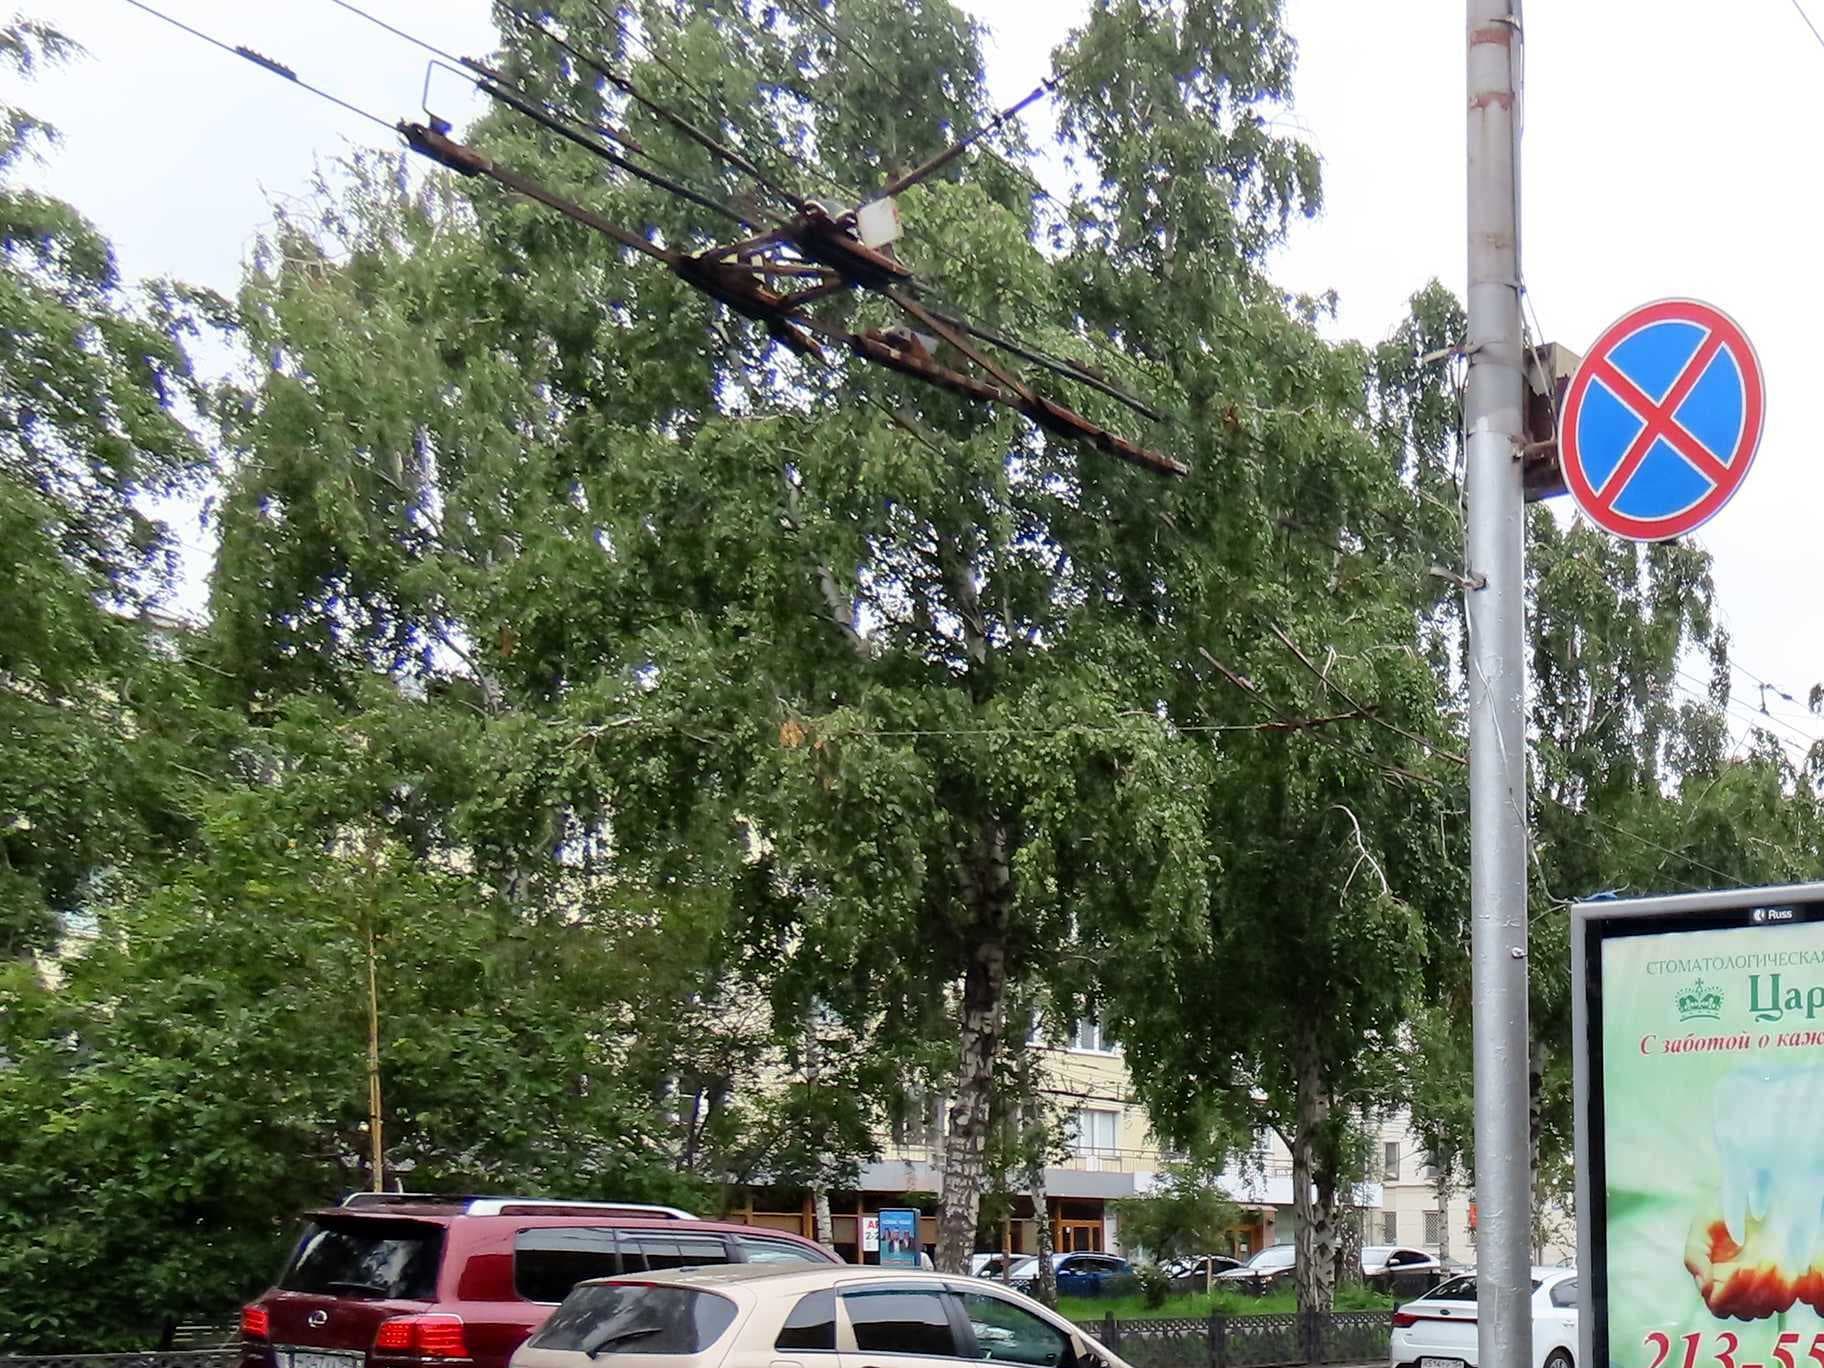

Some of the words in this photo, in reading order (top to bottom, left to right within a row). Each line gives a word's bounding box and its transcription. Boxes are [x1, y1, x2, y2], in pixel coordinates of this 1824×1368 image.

[1768, 909, 1793, 920] Russ
[1640, 1034, 1657, 1055] С
[1663, 1030, 1750, 1054] заботой
[1758, 1036, 1769, 1049] о
